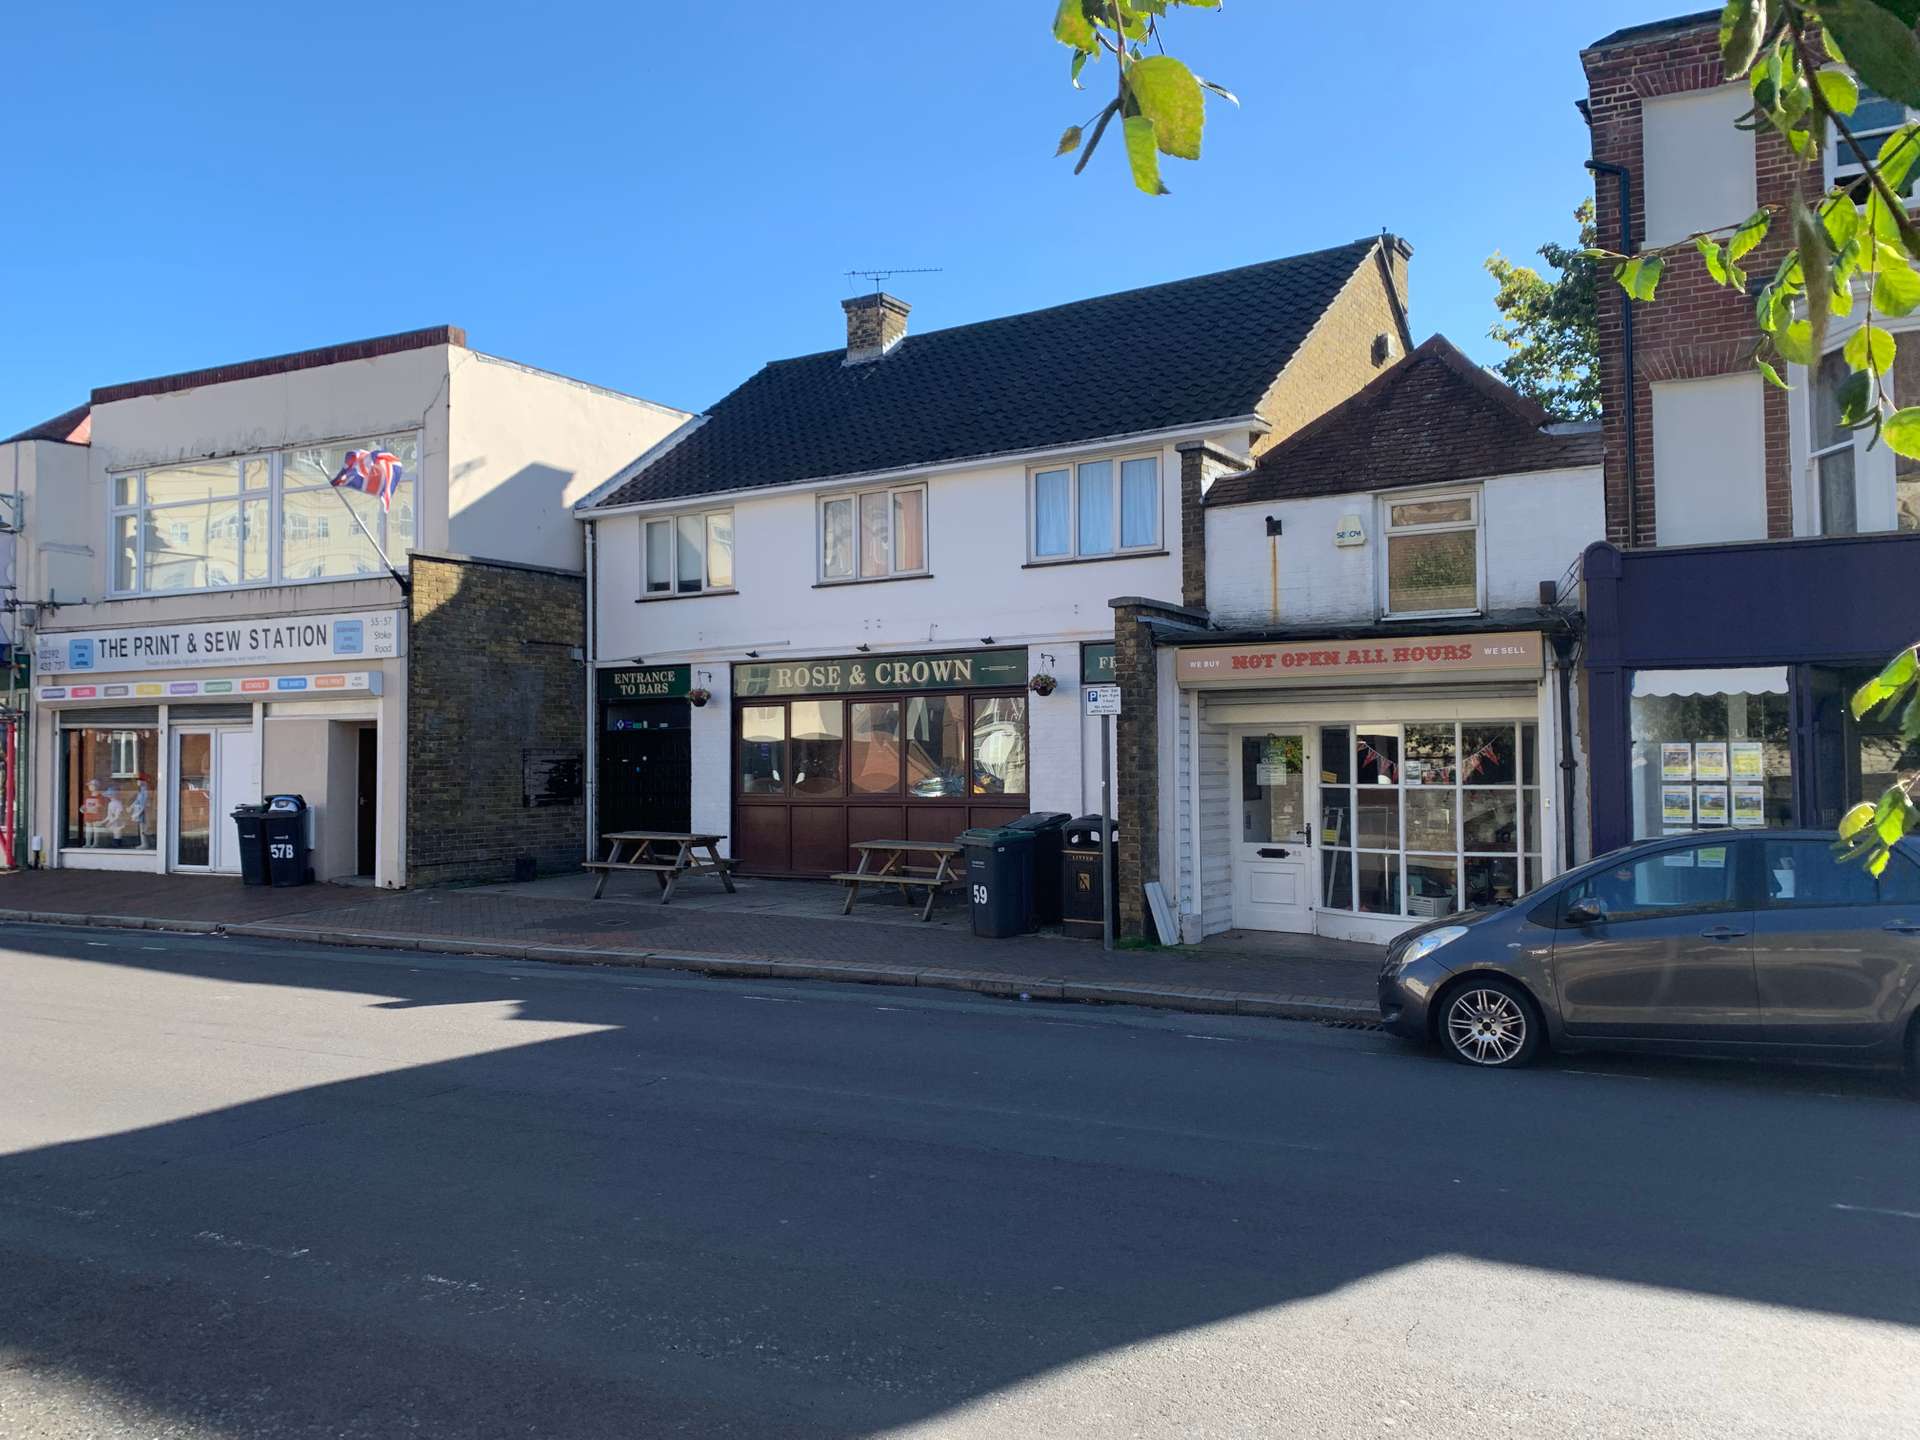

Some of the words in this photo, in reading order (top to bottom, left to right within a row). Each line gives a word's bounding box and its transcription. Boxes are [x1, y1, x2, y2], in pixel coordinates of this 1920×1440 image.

[98, 637, 128, 658] THE
[134, 633, 180, 656] PRINT
[187, 632, 197, 653] &
[204, 629, 241, 653] SEW
[249, 623, 327, 650] STATION
[1231, 653, 1277, 669] NOT
[1281, 651, 1341, 668] OPEN
[1345, 648, 1388, 665] ALL
[1392, 644, 1472, 662] HOURS
[1483, 647, 1498, 655] WE
[1501, 646, 1526, 655] SELL
[1204, 660, 1220, 668] BUY
[614, 670, 675, 684] ENTRANCE
[776, 664, 841, 688] ROSE
[848, 664, 867, 685] &
[875, 659, 973, 685] CROWN
[620, 684, 636, 695] TO
[639, 683, 669, 694] BARS
[270, 844, 294, 859] 57B
[973, 884, 988, 905] 59
